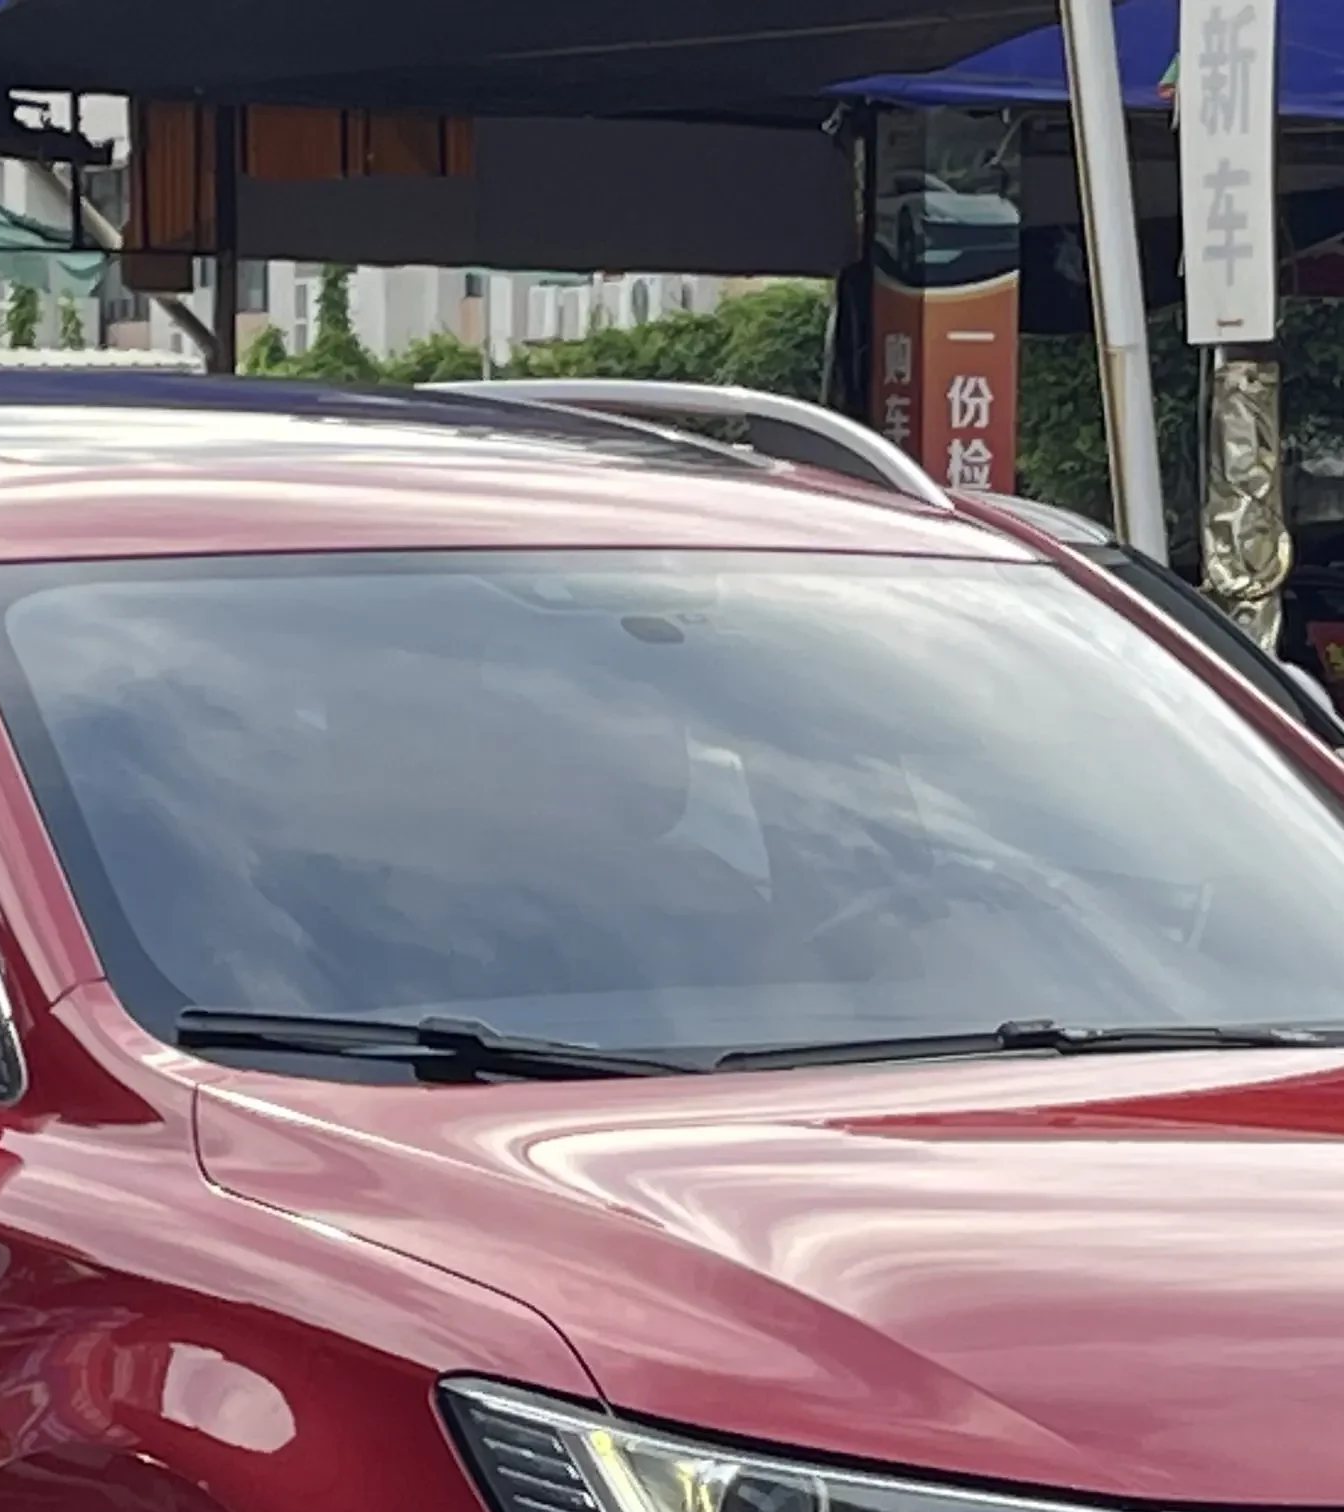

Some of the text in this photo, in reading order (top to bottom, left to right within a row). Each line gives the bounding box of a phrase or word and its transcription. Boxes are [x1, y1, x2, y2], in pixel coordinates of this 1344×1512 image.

[1199, 4, 1257, 288] 新车
[946, 330, 995, 490] 一份检
